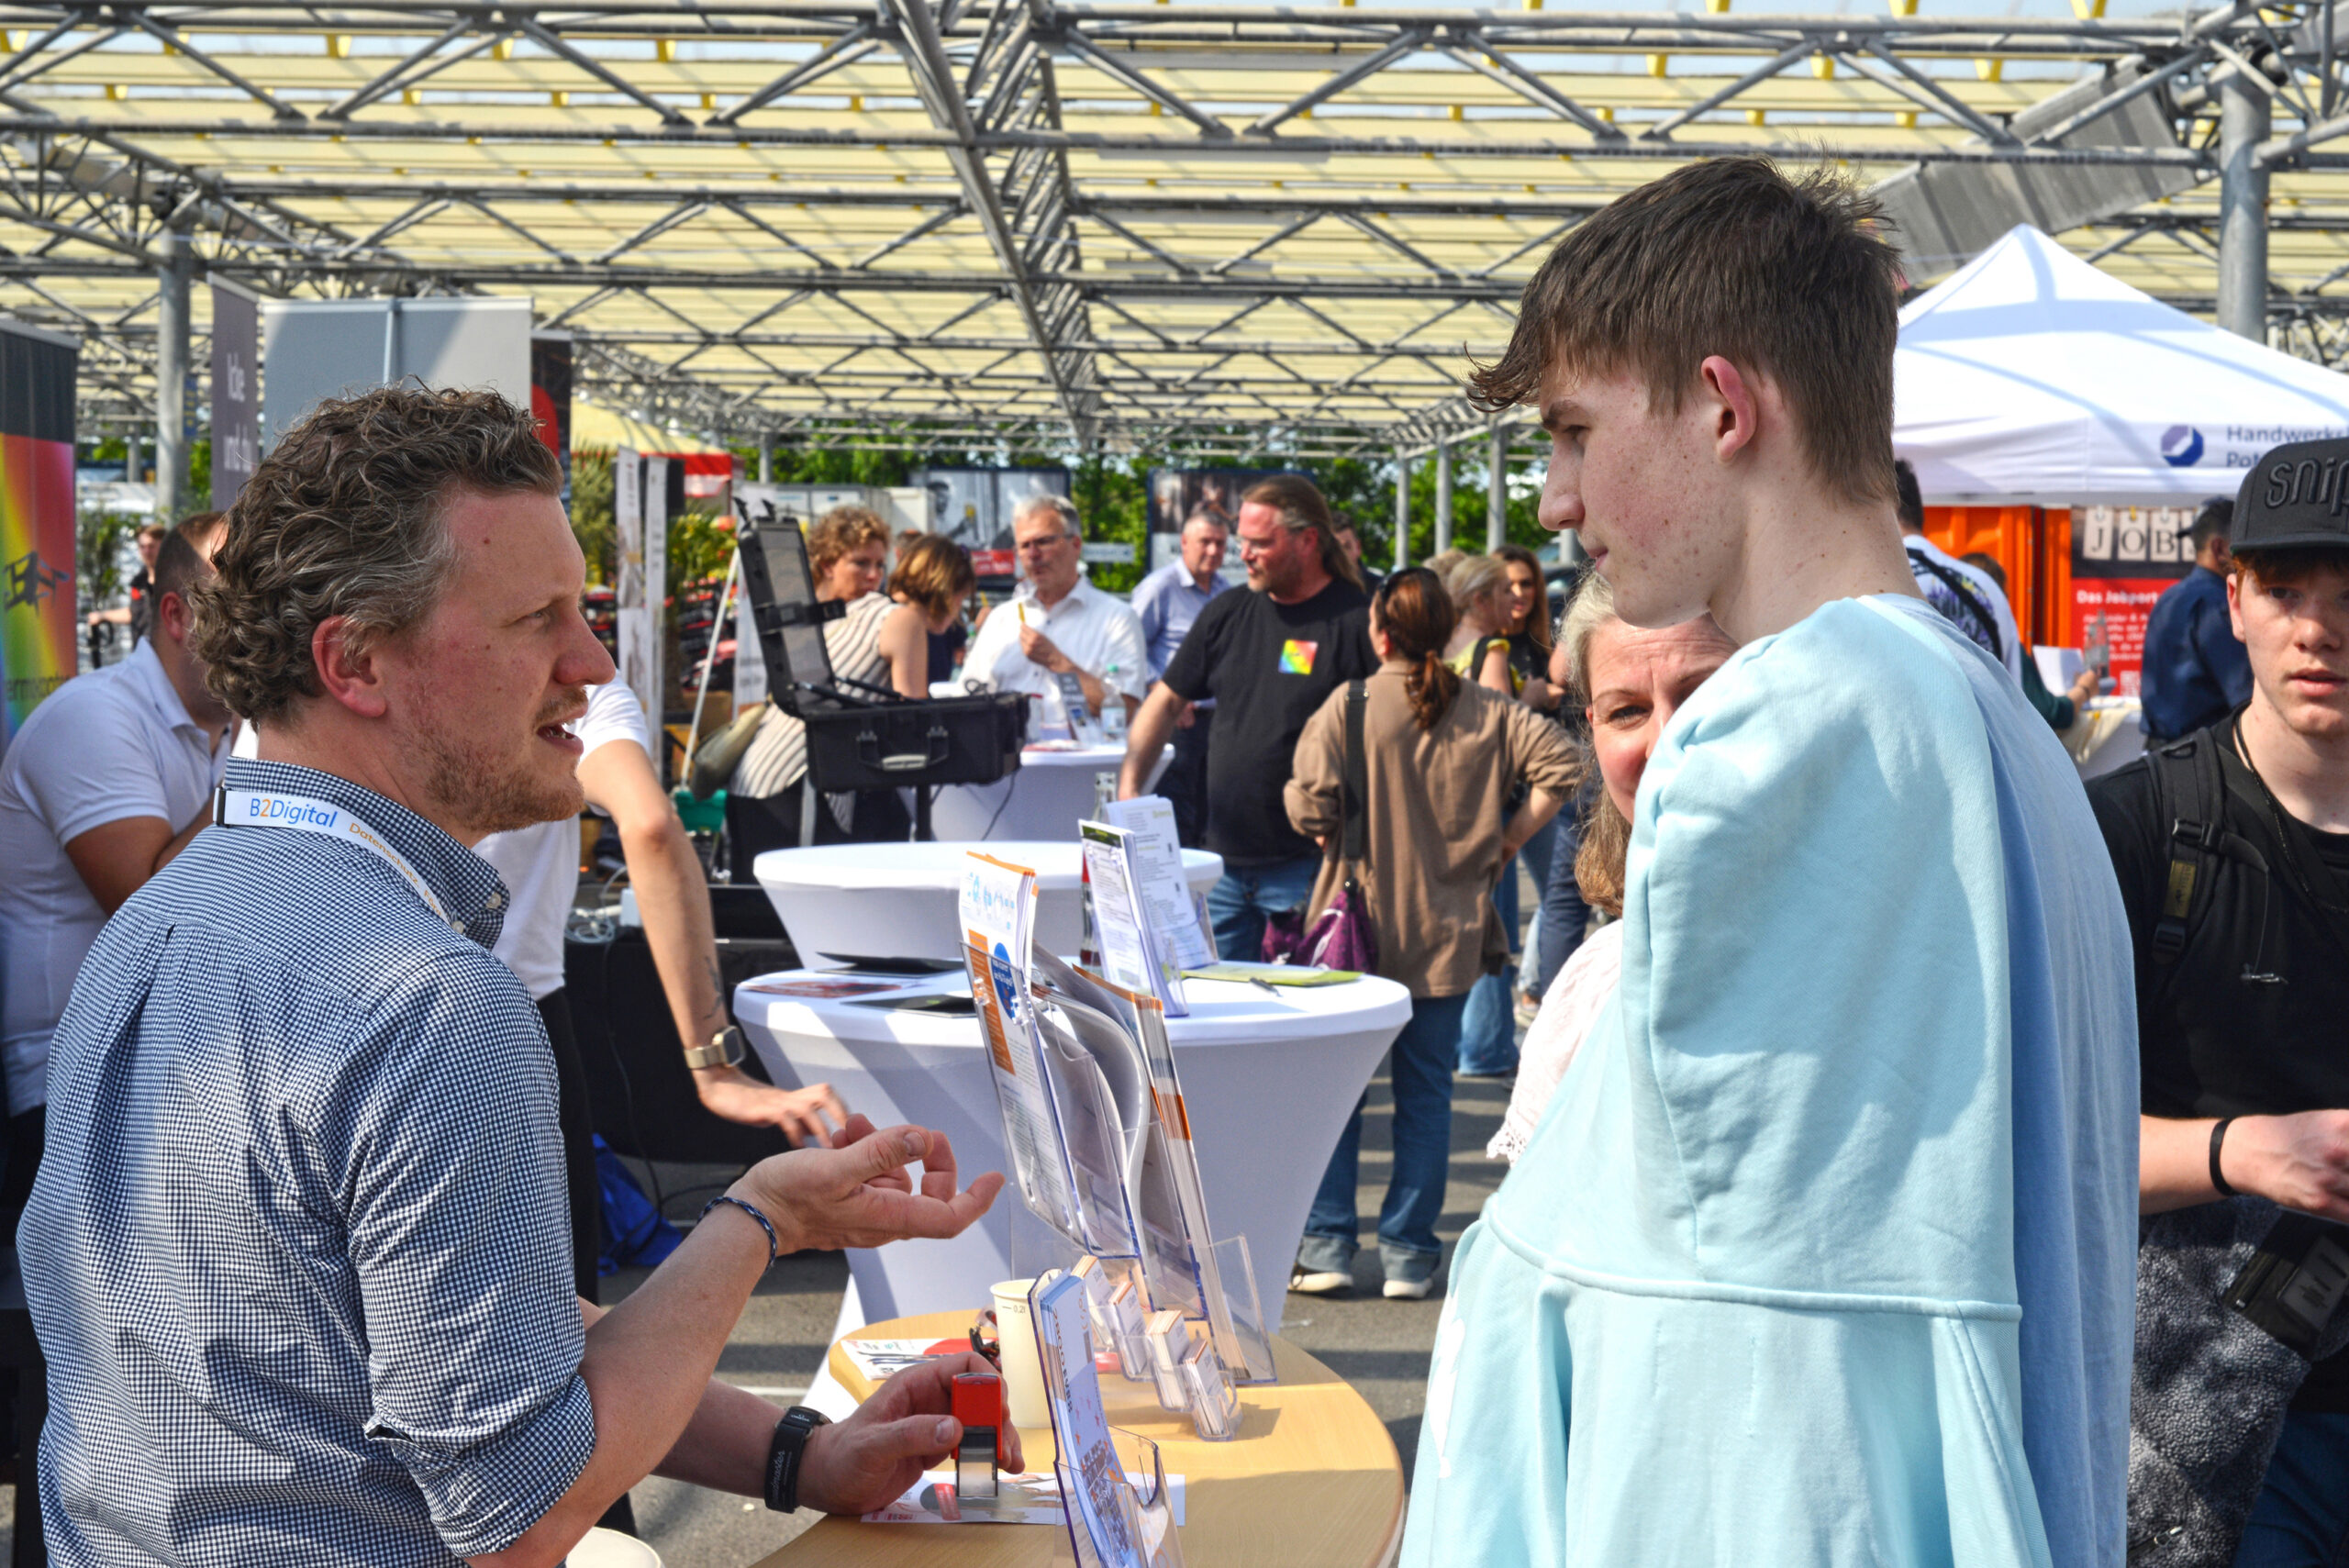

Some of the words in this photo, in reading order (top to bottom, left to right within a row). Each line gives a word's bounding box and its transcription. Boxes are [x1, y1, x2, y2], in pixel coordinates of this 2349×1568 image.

[2227, 426, 2349, 443] Handwerks
[2227, 451, 2260, 467] Pot
[2091, 527, 2196, 554] JOB
[250, 798, 338, 828] B2Digital
